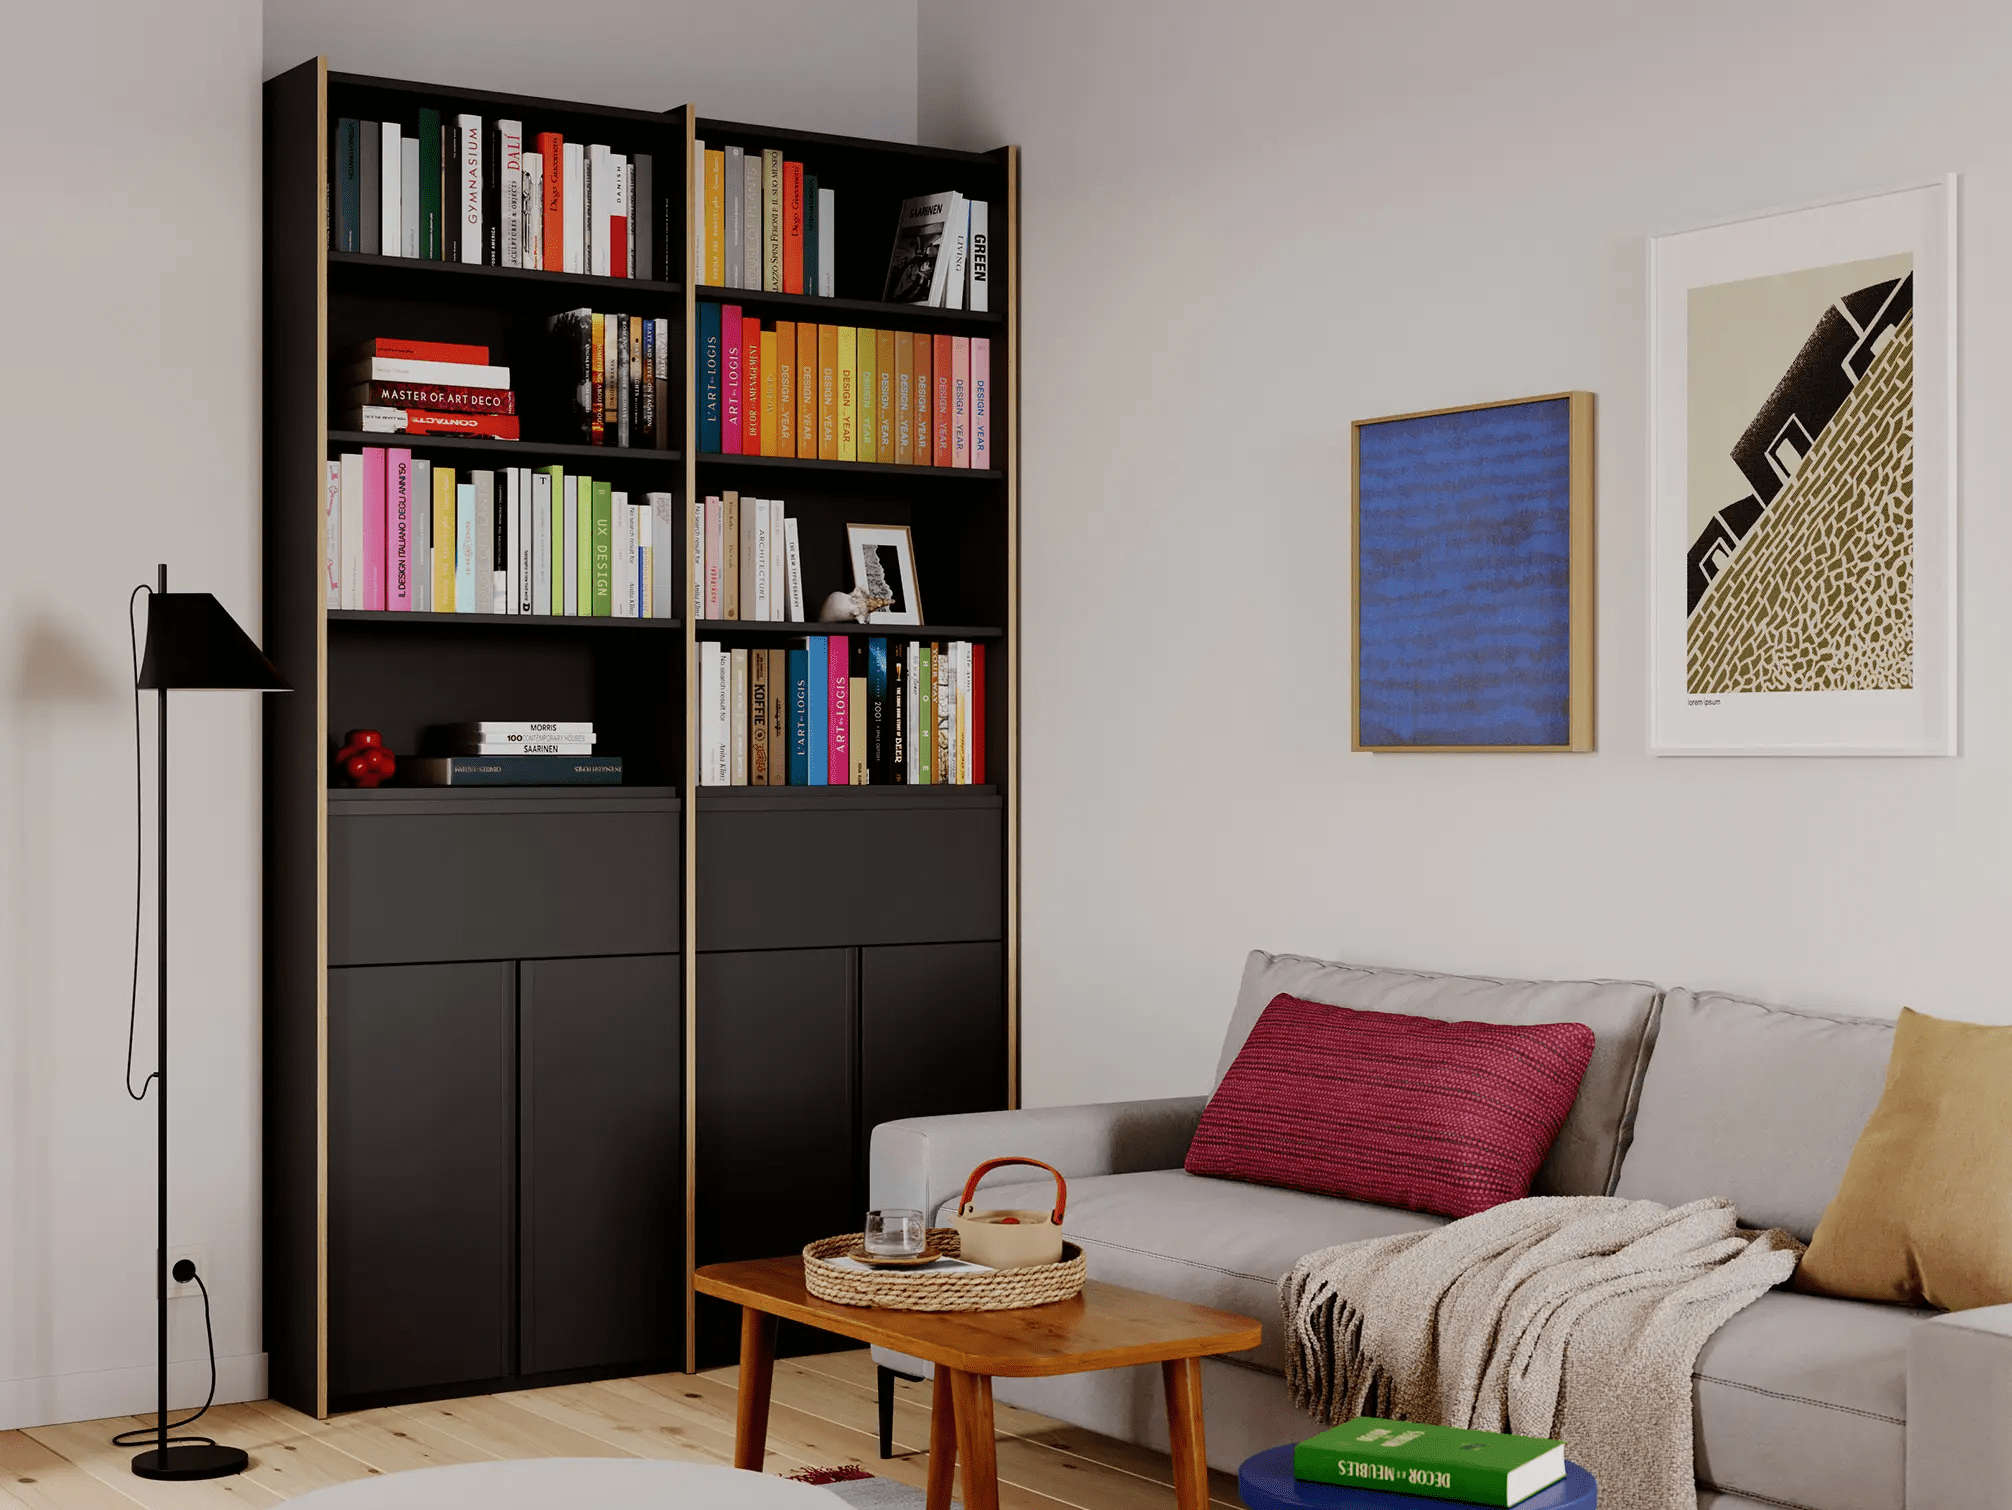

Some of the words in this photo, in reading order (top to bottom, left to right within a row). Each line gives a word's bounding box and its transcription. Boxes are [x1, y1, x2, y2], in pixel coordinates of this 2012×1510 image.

[503, 133, 521, 172] DALÍ
[771, 151, 779, 179] MUSEO
[468, 127, 478, 225] GYMNASIUM
[771, 180, 779, 196] SUO
[510, 179, 518, 210] OBJECTS
[549, 186, 560, 212] Diego
[909, 203, 944, 220] SAARINEN
[510, 219, 518, 264] SCULPTURES
[770, 245, 779, 264] SPINI
[955, 235, 964, 272] LIVING
[974, 234, 987, 282] GREEN
[596, 343, 604, 383] SOMETHING
[706, 335, 717, 375] LOGIS
[728, 346, 739, 387] LOGIS
[380, 388, 427, 402] MASTER
[429, 391, 445, 403] OF
[447, 393, 468, 405] ART
[470, 395, 501, 407] DECO
[596, 383, 604, 406] ABOUT
[647, 382, 653, 393] ON
[781, 364, 790, 403] DESIGN
[803, 366, 812, 404] DESIGN
[823, 367, 833, 405] DESIGN
[842, 369, 851, 407] DESIGN
[880, 371, 890, 410] DESIGN
[899, 373, 909, 411] DESIGN
[917, 375, 927, 413] DESIGN
[939, 377, 948, 413] DESIGN
[955, 378, 964, 415] DESIGN
[707, 383, 717, 422] L'ART
[728, 396, 739, 426] ART
[976, 380, 985, 417] DESIGN
[781, 411, 790, 439] YEAR
[803, 412, 812, 440] YEAR
[823, 414, 833, 442] YEAR
[842, 415, 851, 443] YEAR
[880, 418, 890, 445] YEAR
[899, 420, 909, 447] YEAR
[917, 421, 927, 448] YEAR
[939, 423, 948, 449] YEAR
[955, 424, 964, 451] YEAR
[976, 425, 985, 451] YEAR
[539, 476, 548, 485] T
[397, 496, 406, 521] DEGLI
[628, 507, 635, 517] No
[694, 505, 701, 516] No
[397, 521, 406, 559] ITALIANO
[596, 518, 608, 536] UX
[397, 559, 406, 591] DESIGN
[596, 544, 608, 596] DESIGN
[397, 590, 406, 598] IL
[522, 602, 531, 612] D
[719, 655, 727, 666] No
[931, 648, 939, 678] YOUR
[719, 667, 727, 691] search
[931, 682, 939, 704] WAY
[719, 691, 727, 711] result
[754, 683, 766, 726] KOFFIE
[797, 678, 806, 714] LOGIS
[835, 676, 846, 716] LOGIS
[1687, 698, 1703, 706] lorem
[1703, 697, 1721, 708] ipsum
[719, 711, 727, 722] for
[874, 701, 882, 722] 2001
[507, 734, 523, 742] 100
[522, 734, 564, 742] CONTEMPORARY
[564, 734, 586, 743] HOUSES
[530, 724, 557, 732] MORRIS
[797, 721, 806, 756] L'ART
[835, 725, 846, 754] ART
[523, 745, 559, 753] SAARINEN
[719, 742, 727, 763] Anita
[1337, 1459, 1395, 1482] MEUBLES
[1408, 1468, 1451, 1489] DECOR
